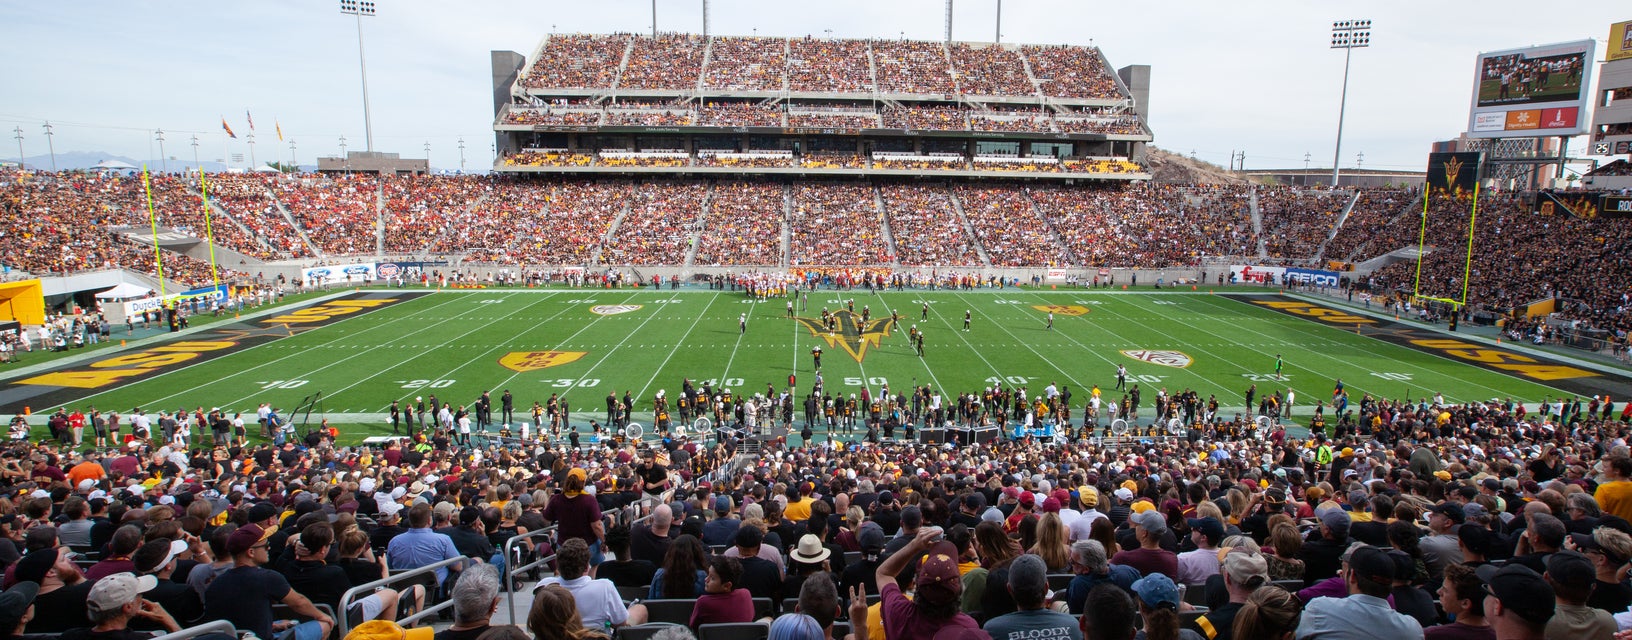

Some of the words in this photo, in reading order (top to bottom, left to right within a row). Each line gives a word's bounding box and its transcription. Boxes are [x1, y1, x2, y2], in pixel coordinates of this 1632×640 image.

[1596, 143, 1608, 153] 25
[1286, 271, 1338, 287] GEICO
[401, 379, 456, 388] 20
[552, 379, 601, 387] 30
[699, 378, 745, 386] 40
[844, 377, 888, 386] 50
[985, 376, 1029, 384] 40
[1008, 627, 1071, 640] BLOODY
